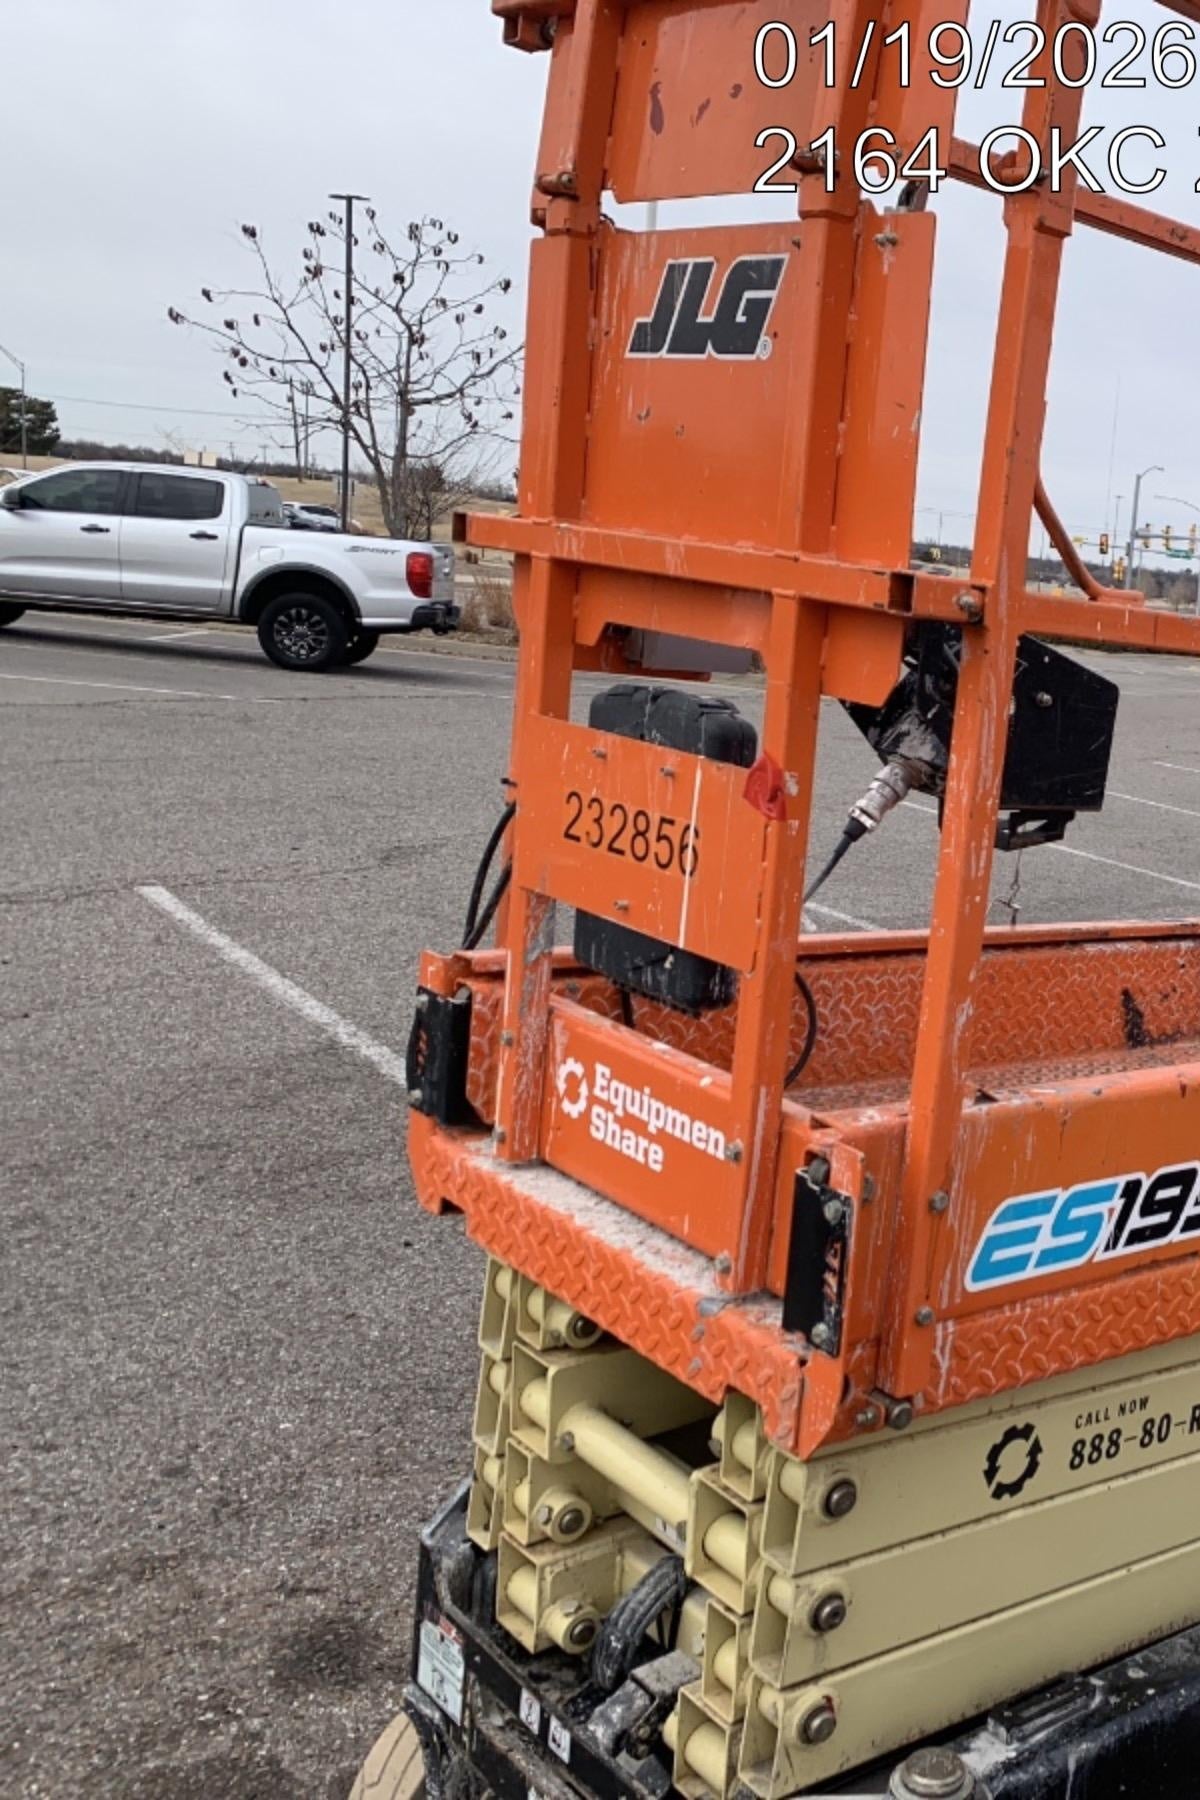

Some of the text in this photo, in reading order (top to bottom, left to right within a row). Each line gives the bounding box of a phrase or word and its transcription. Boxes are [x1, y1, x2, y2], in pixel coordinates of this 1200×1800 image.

[624, 252, 790, 361] JLG
[564, 790, 699, 878] 232856
[589, 1104, 665, 1173] Share
[592, 1062, 728, 1161] Equipmen
[1074, 1395, 1150, 1430] CALL NOW
